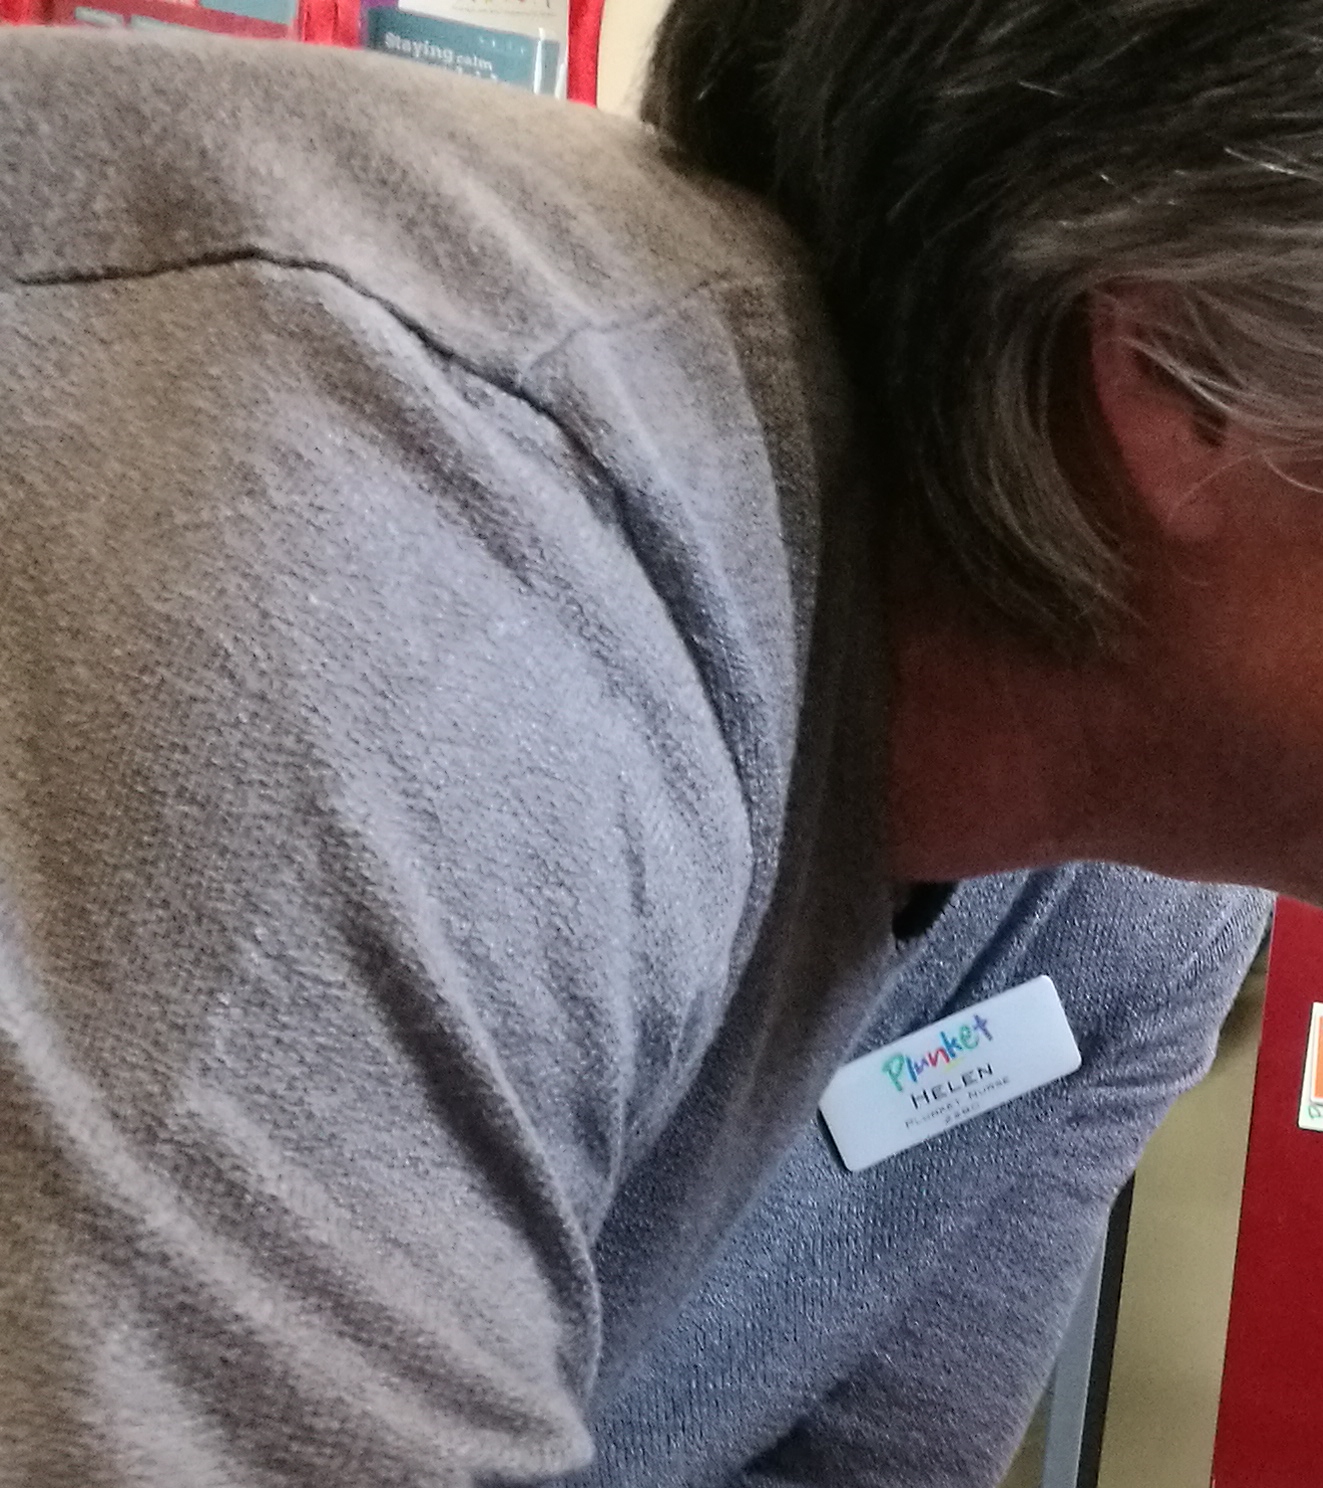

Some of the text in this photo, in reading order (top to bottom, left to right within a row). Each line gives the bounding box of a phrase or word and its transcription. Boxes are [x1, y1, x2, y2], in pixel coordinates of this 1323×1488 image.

[456, 52, 494, 72] calm
[881, 1014, 994, 1093] Plunket
[909, 1062, 994, 1110] HELEN
